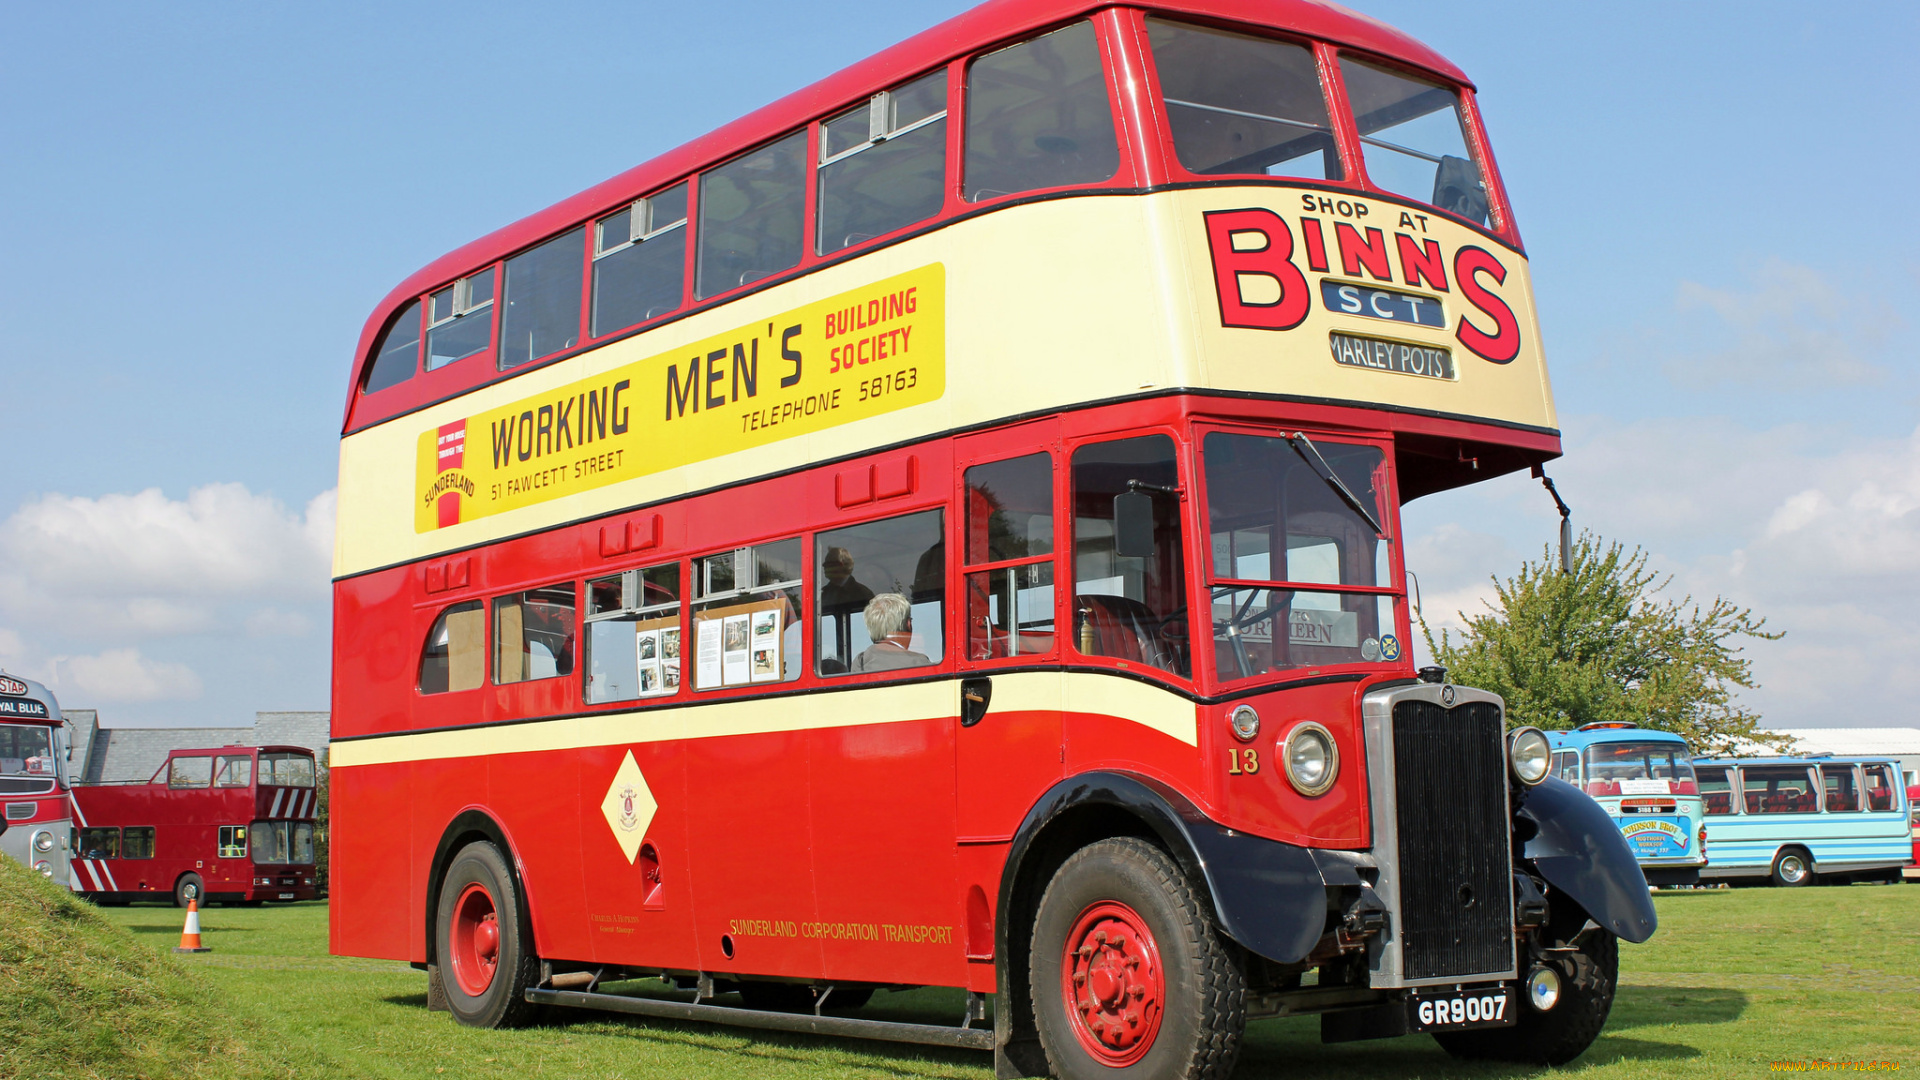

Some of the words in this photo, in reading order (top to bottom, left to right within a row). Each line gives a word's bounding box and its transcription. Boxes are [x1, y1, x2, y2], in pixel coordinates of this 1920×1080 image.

[1301, 193, 1369, 219] SHOP
[1398, 211, 1428, 233] AT
[1203, 207, 1521, 366] BINNS
[1338, 285, 1424, 323] SCT
[825, 286, 917, 340] BUILDING
[830, 325, 912, 374] SOCIETY
[1330, 335, 1395, 370] MARLEY
[1400, 344, 1443, 378] POTS
[491, 379, 630, 470] WORKING
[666, 322, 802, 421] MEN'S
[742, 388, 841, 433] TELEPHONE
[859, 367, 917, 401] 58163
[424, 472, 475, 508] SUNDERLAND
[491, 483, 502, 500] 51
[507, 465, 567, 496] FAWCETT
[575, 449, 624, 478] STREET
[18, 702, 45, 714] BLUE
[1228, 748, 1260, 775] 13
[1622, 821, 1657, 836] JOHNSON
[729, 919, 798, 938] SUNDERLAND
[801, 922, 879, 941] CORPORATION
[882, 924, 953, 944] TRANSPORT
[1418, 995, 1507, 1025] GR9007
